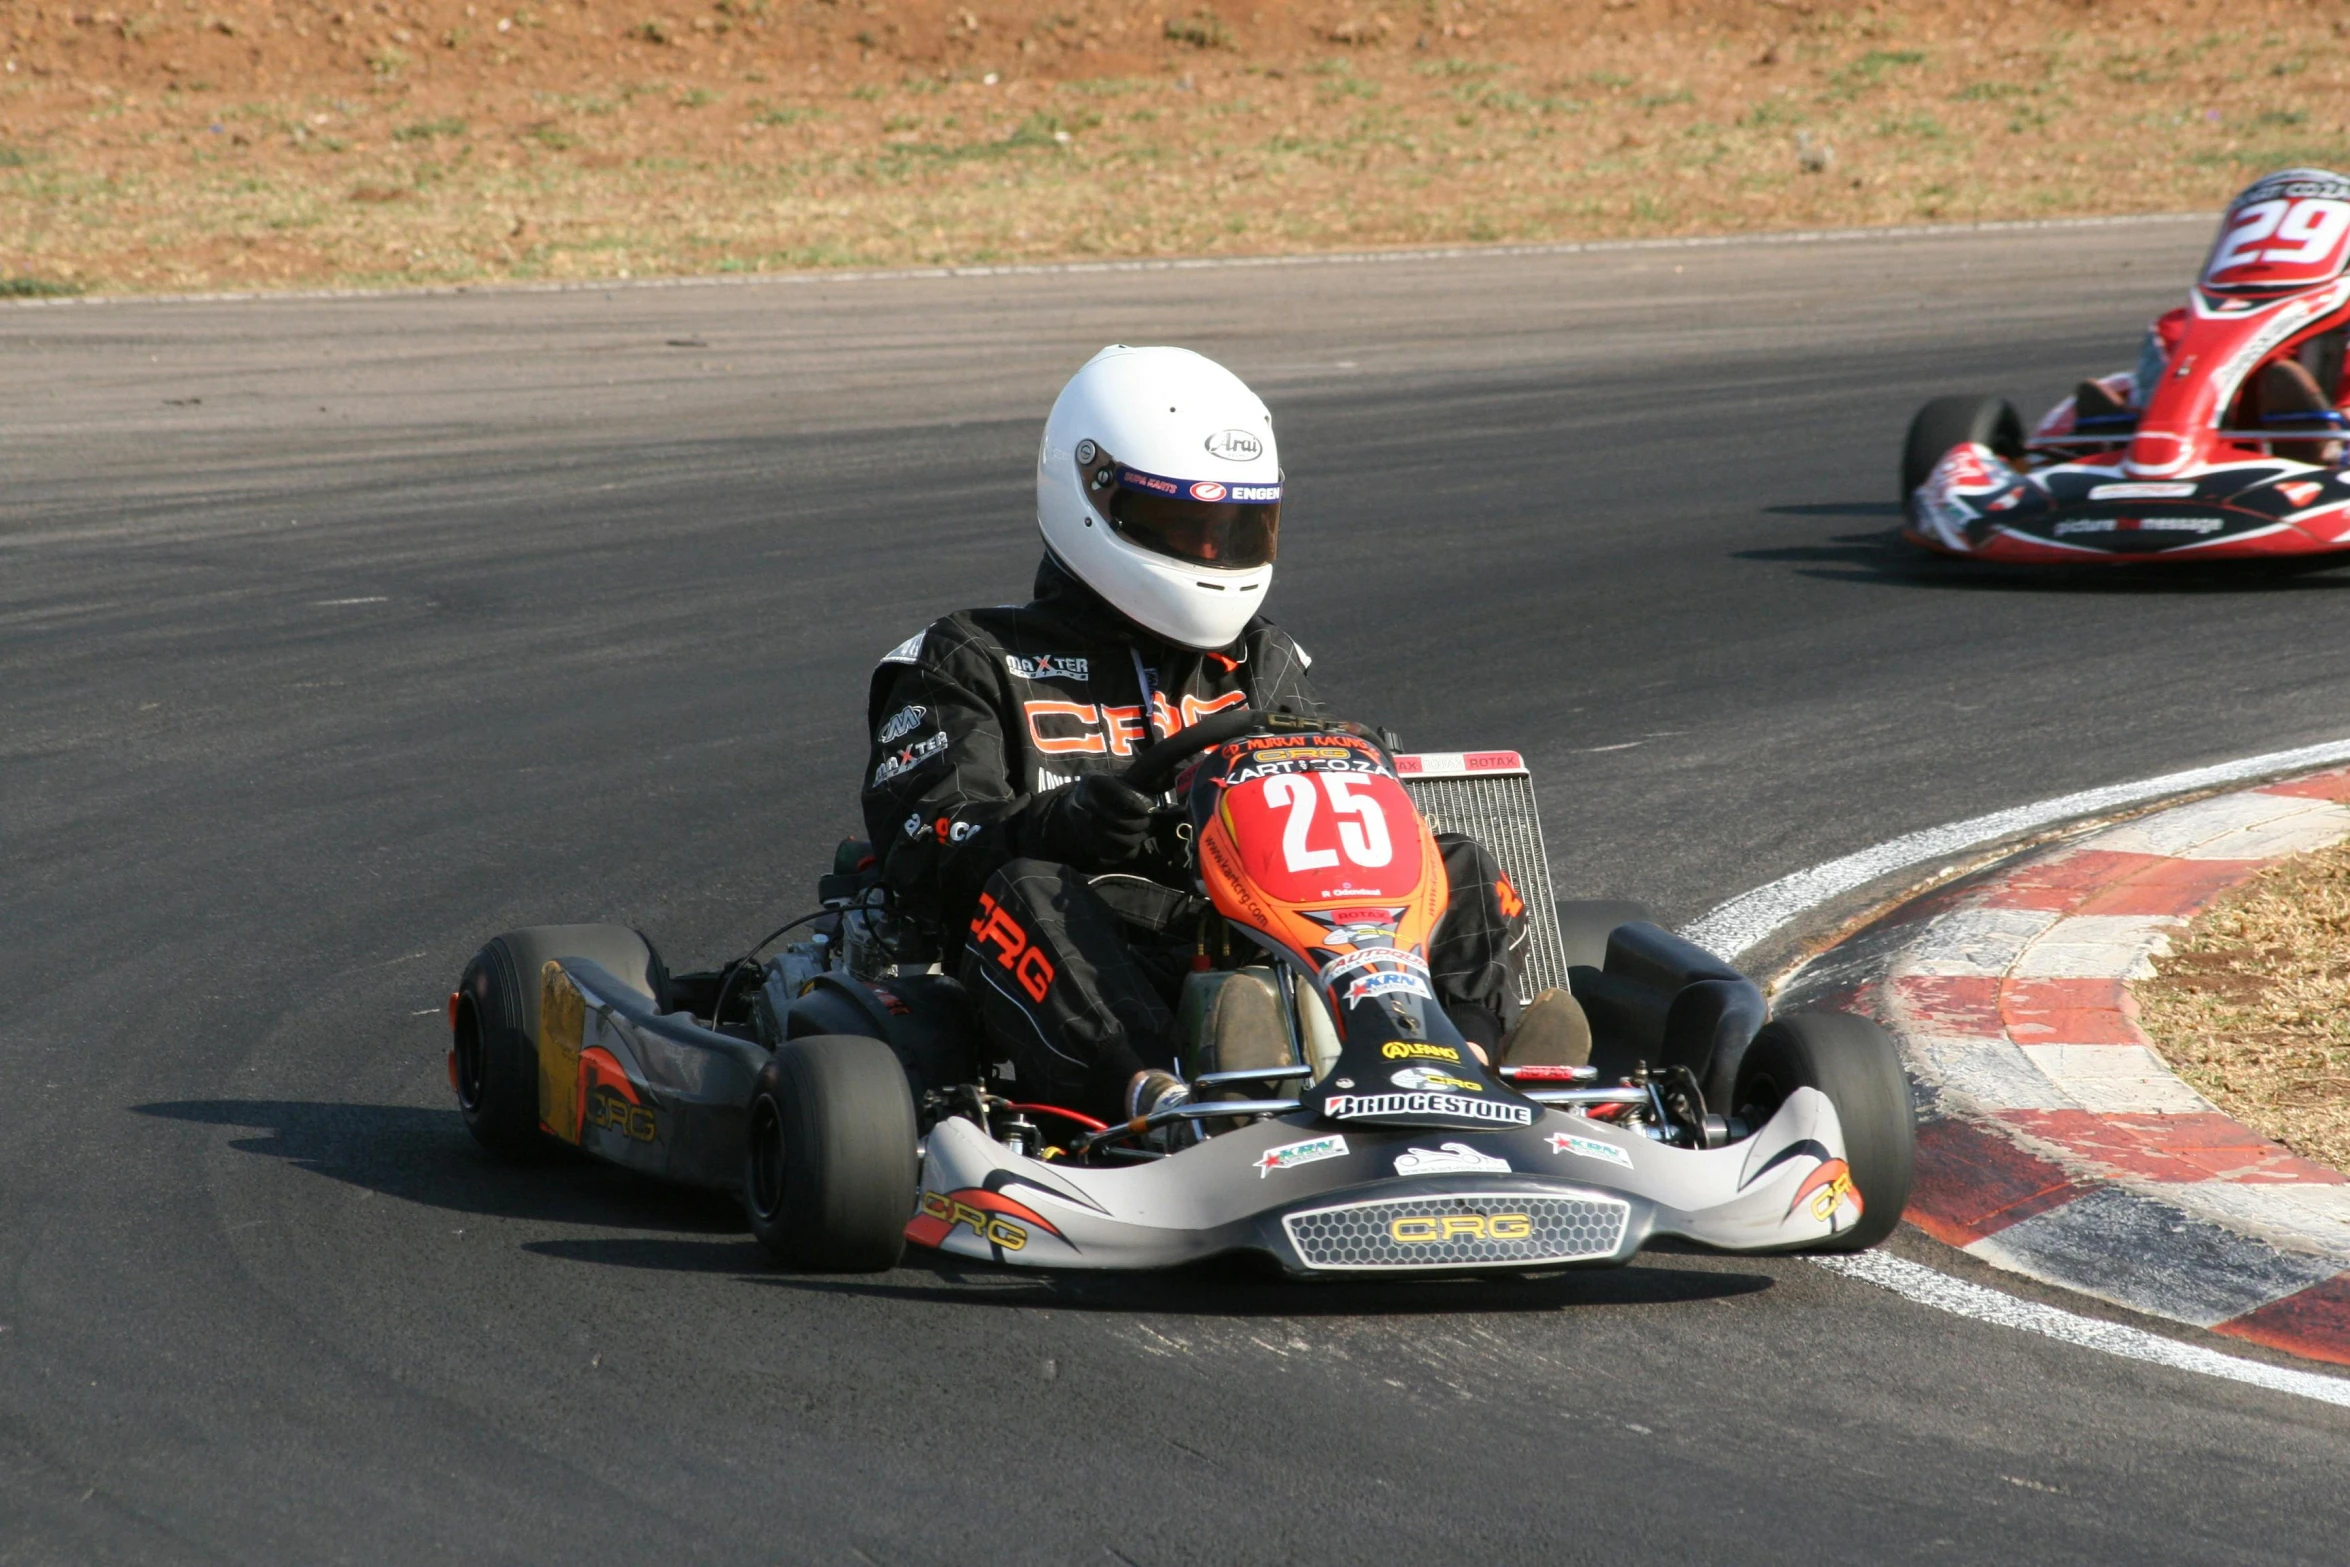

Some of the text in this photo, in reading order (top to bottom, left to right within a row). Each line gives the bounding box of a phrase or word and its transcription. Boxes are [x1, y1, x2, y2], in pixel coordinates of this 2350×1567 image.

[2209, 198, 2350, 274] 29
[1210, 432, 1257, 452] Arai
[1231, 486, 1280, 501] ENGEN
[1247, 736, 1306, 750] MURRAY
[1313, 735, 1368, 749] RACING
[1253, 747, 1351, 763] CRG
[1469, 757, 1516, 768] ROTAX
[1262, 771, 1393, 872] 25
[1321, 889, 1332, 898] R
[1338, 911, 1386, 920] ROTAX
[1366, 974, 1417, 989] KRN
[1425, 1074, 1484, 1092] CRG
[586, 1092, 656, 1142] CRG
[1326, 1093, 1531, 1125] BRIDGESTONE
[1811, 1172, 1852, 1222] CR
[923, 1190, 1028, 1252] CRG
[1391, 1213, 1531, 1243] CRG
